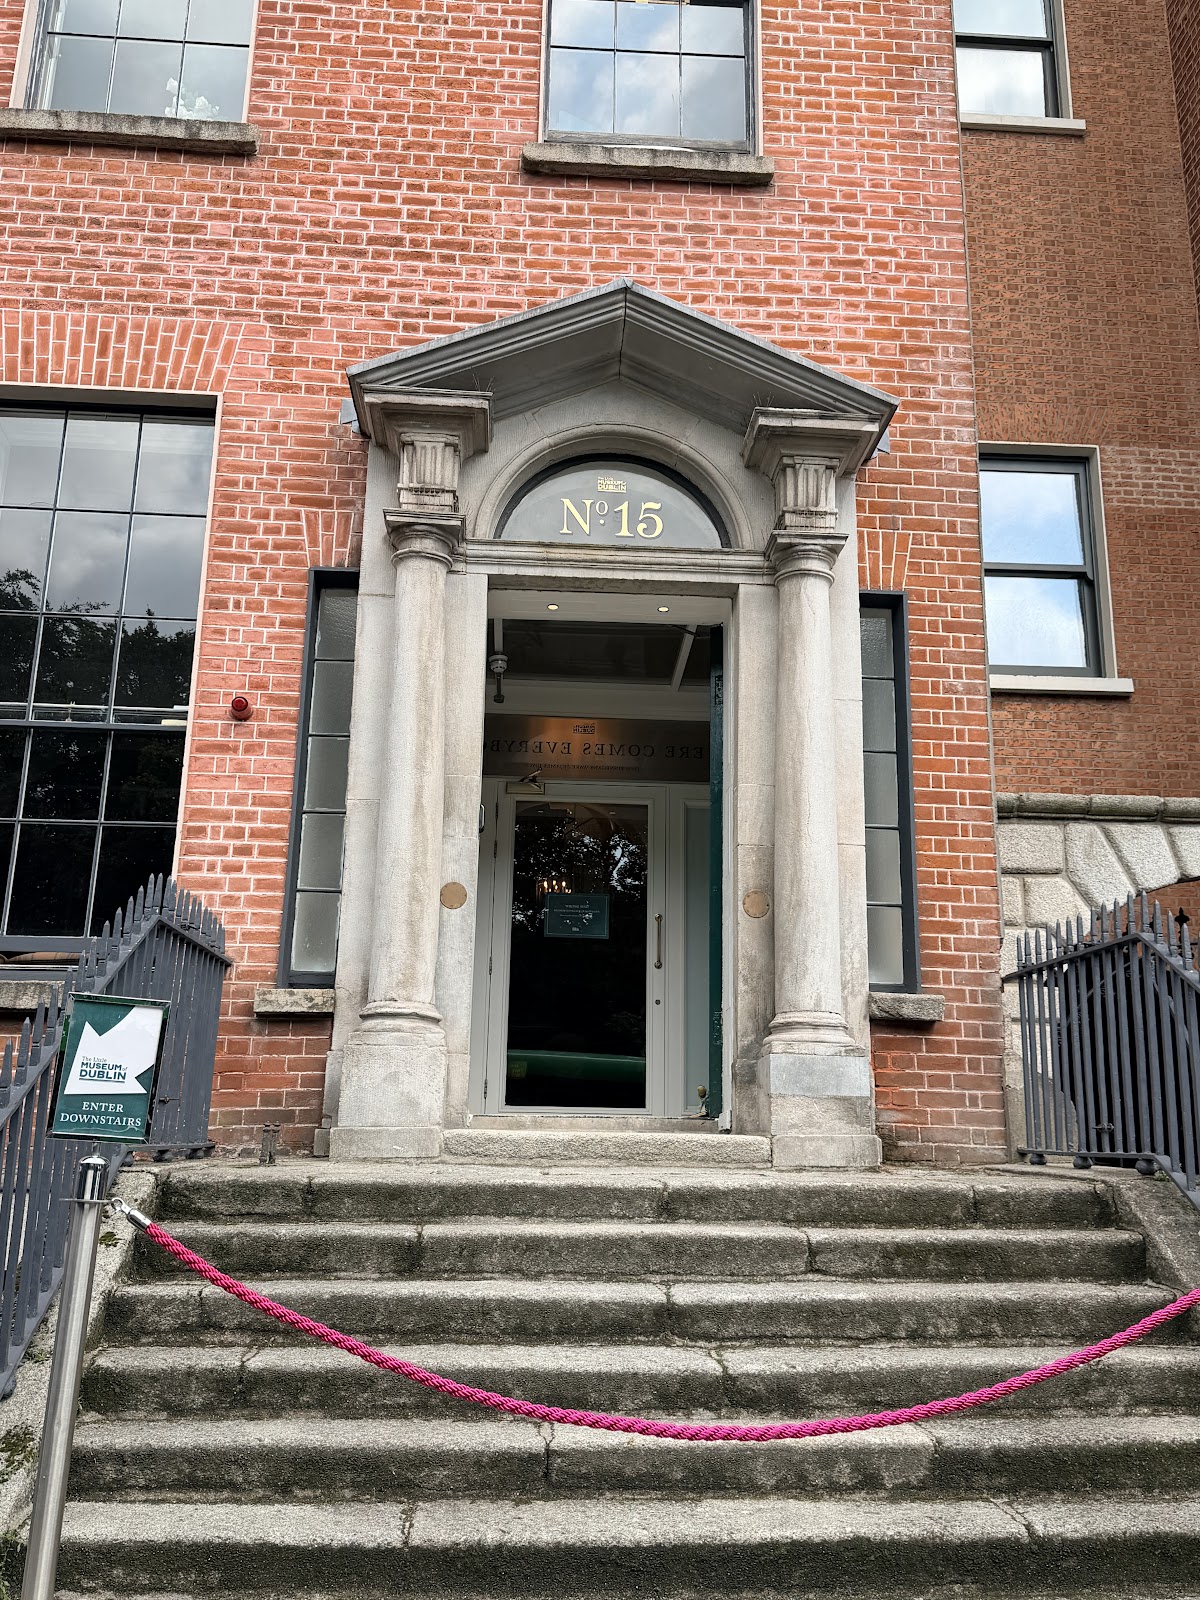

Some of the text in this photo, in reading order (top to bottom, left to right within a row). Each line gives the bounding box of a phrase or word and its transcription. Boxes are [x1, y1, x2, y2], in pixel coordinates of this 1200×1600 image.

[614, 501, 664, 538] 15
[81, 1062, 122, 1071] MUSEUM
[79, 1069, 126, 1080] DUBLIN
[82, 1102, 124, 1113] ENTER
[60, 1112, 142, 1127] DOWNSTAIRS
